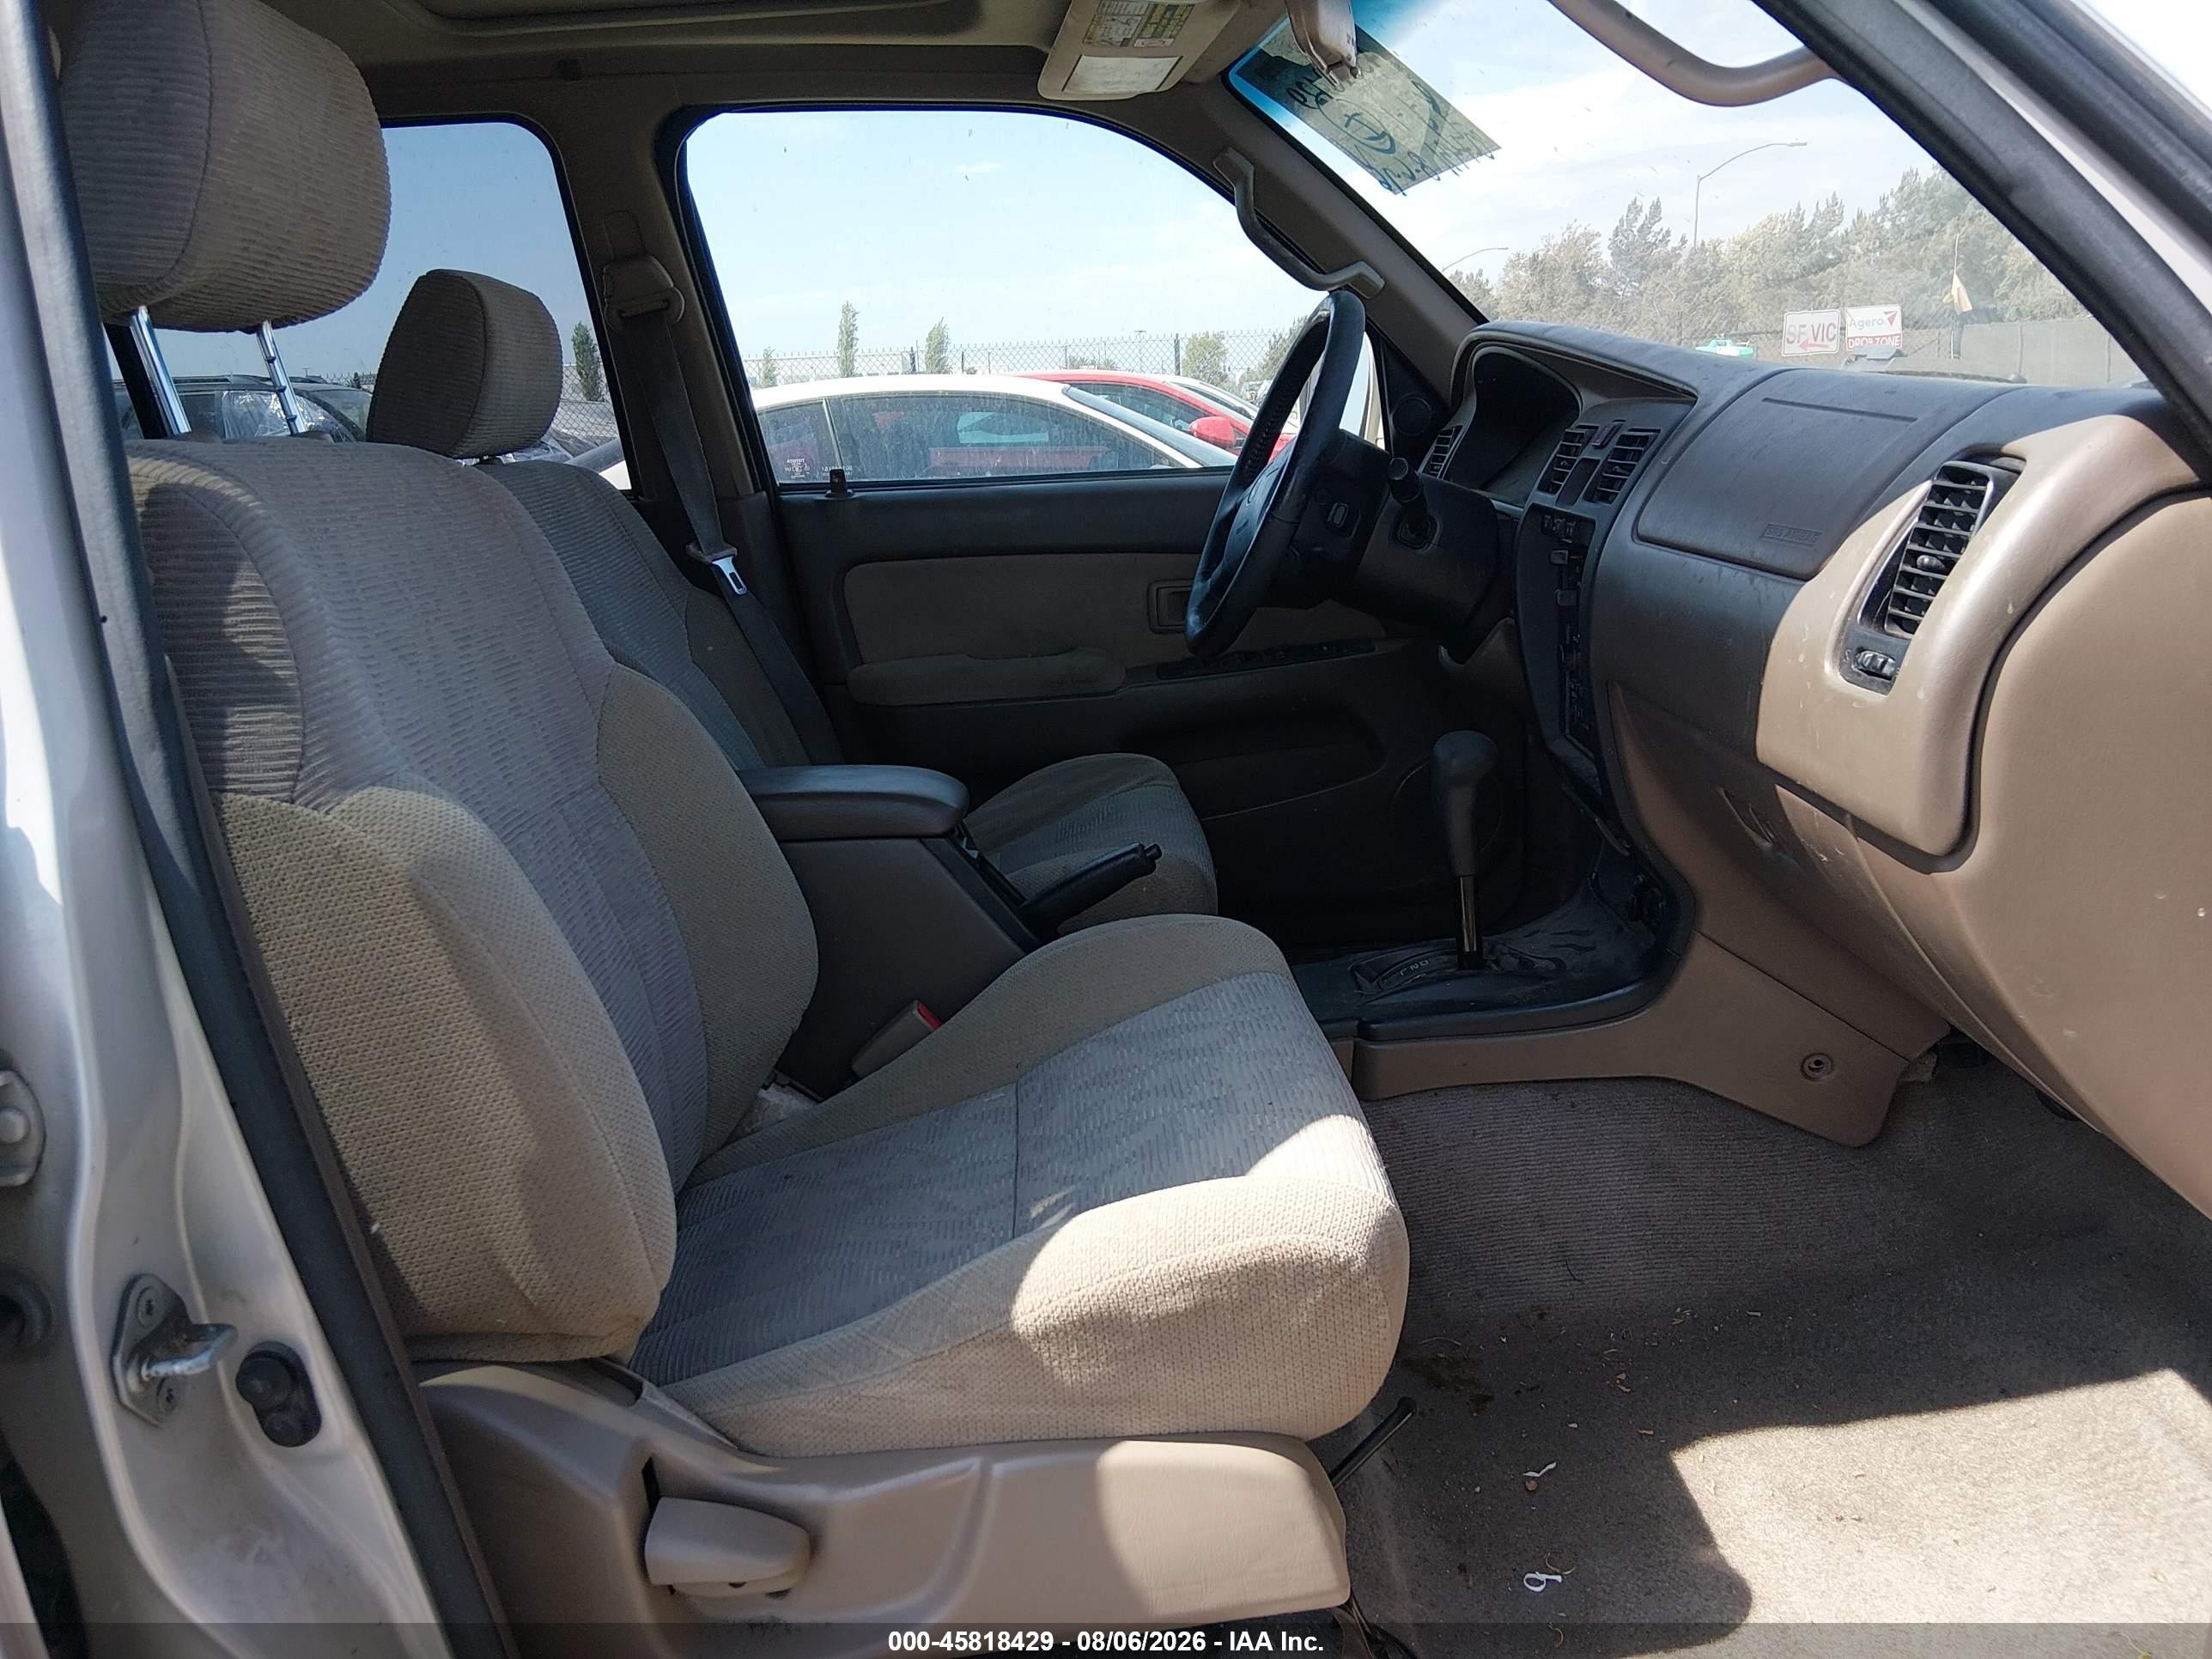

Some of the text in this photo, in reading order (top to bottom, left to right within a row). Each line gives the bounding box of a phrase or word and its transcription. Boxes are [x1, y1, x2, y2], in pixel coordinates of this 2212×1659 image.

[1849, 317, 1884, 331] Agero
[1810, 322, 1837, 343] VIC
[1875, 335, 1900, 346] ZONE
